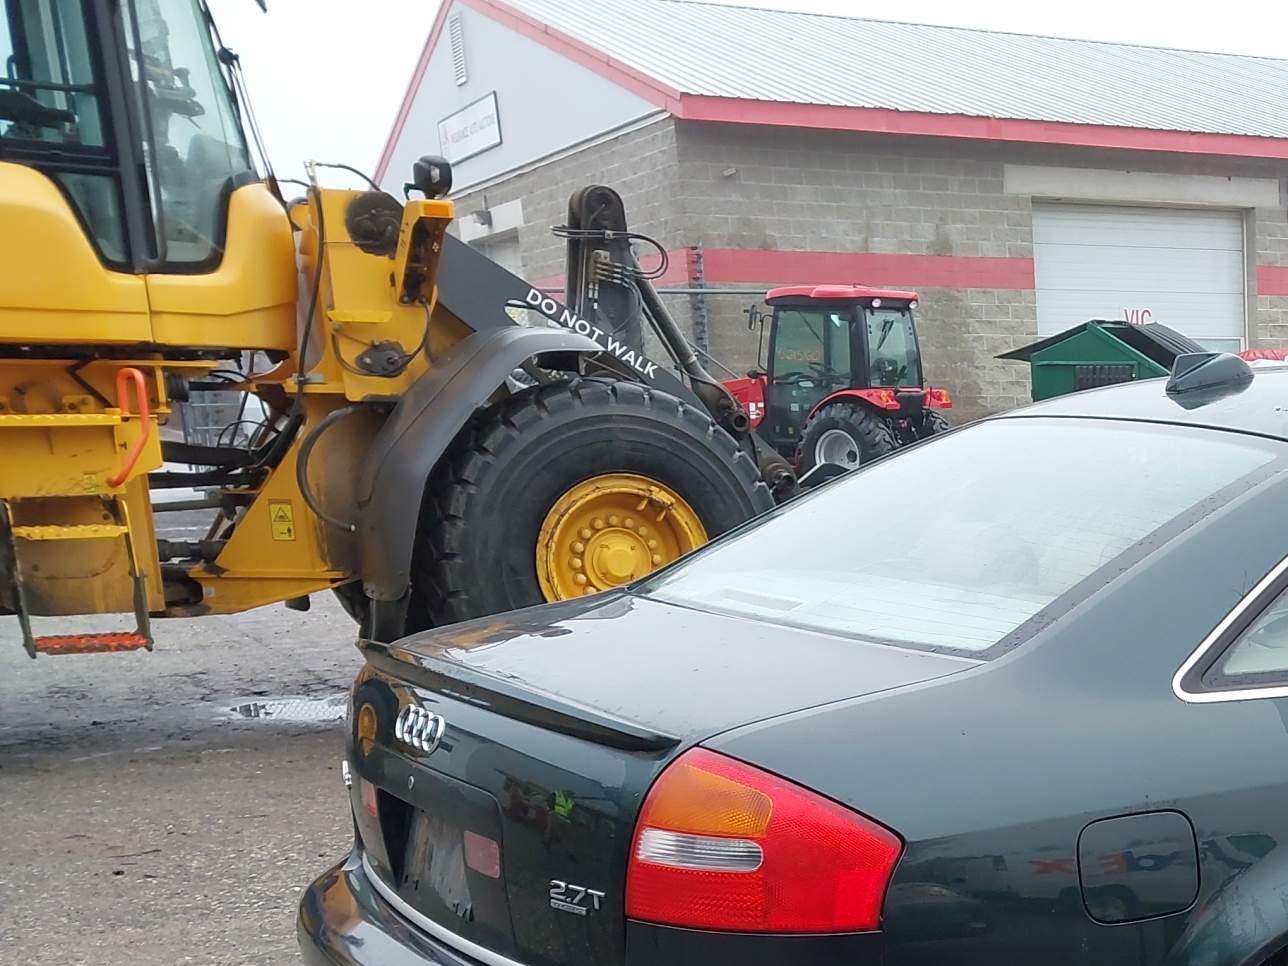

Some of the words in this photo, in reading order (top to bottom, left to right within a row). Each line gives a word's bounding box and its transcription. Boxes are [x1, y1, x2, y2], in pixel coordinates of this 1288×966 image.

[526, 288, 557, 315] DO
[560, 309, 603, 342] NOT
[607, 336, 659, 380] WALK
[549, 880, 605, 910] 2.7T
